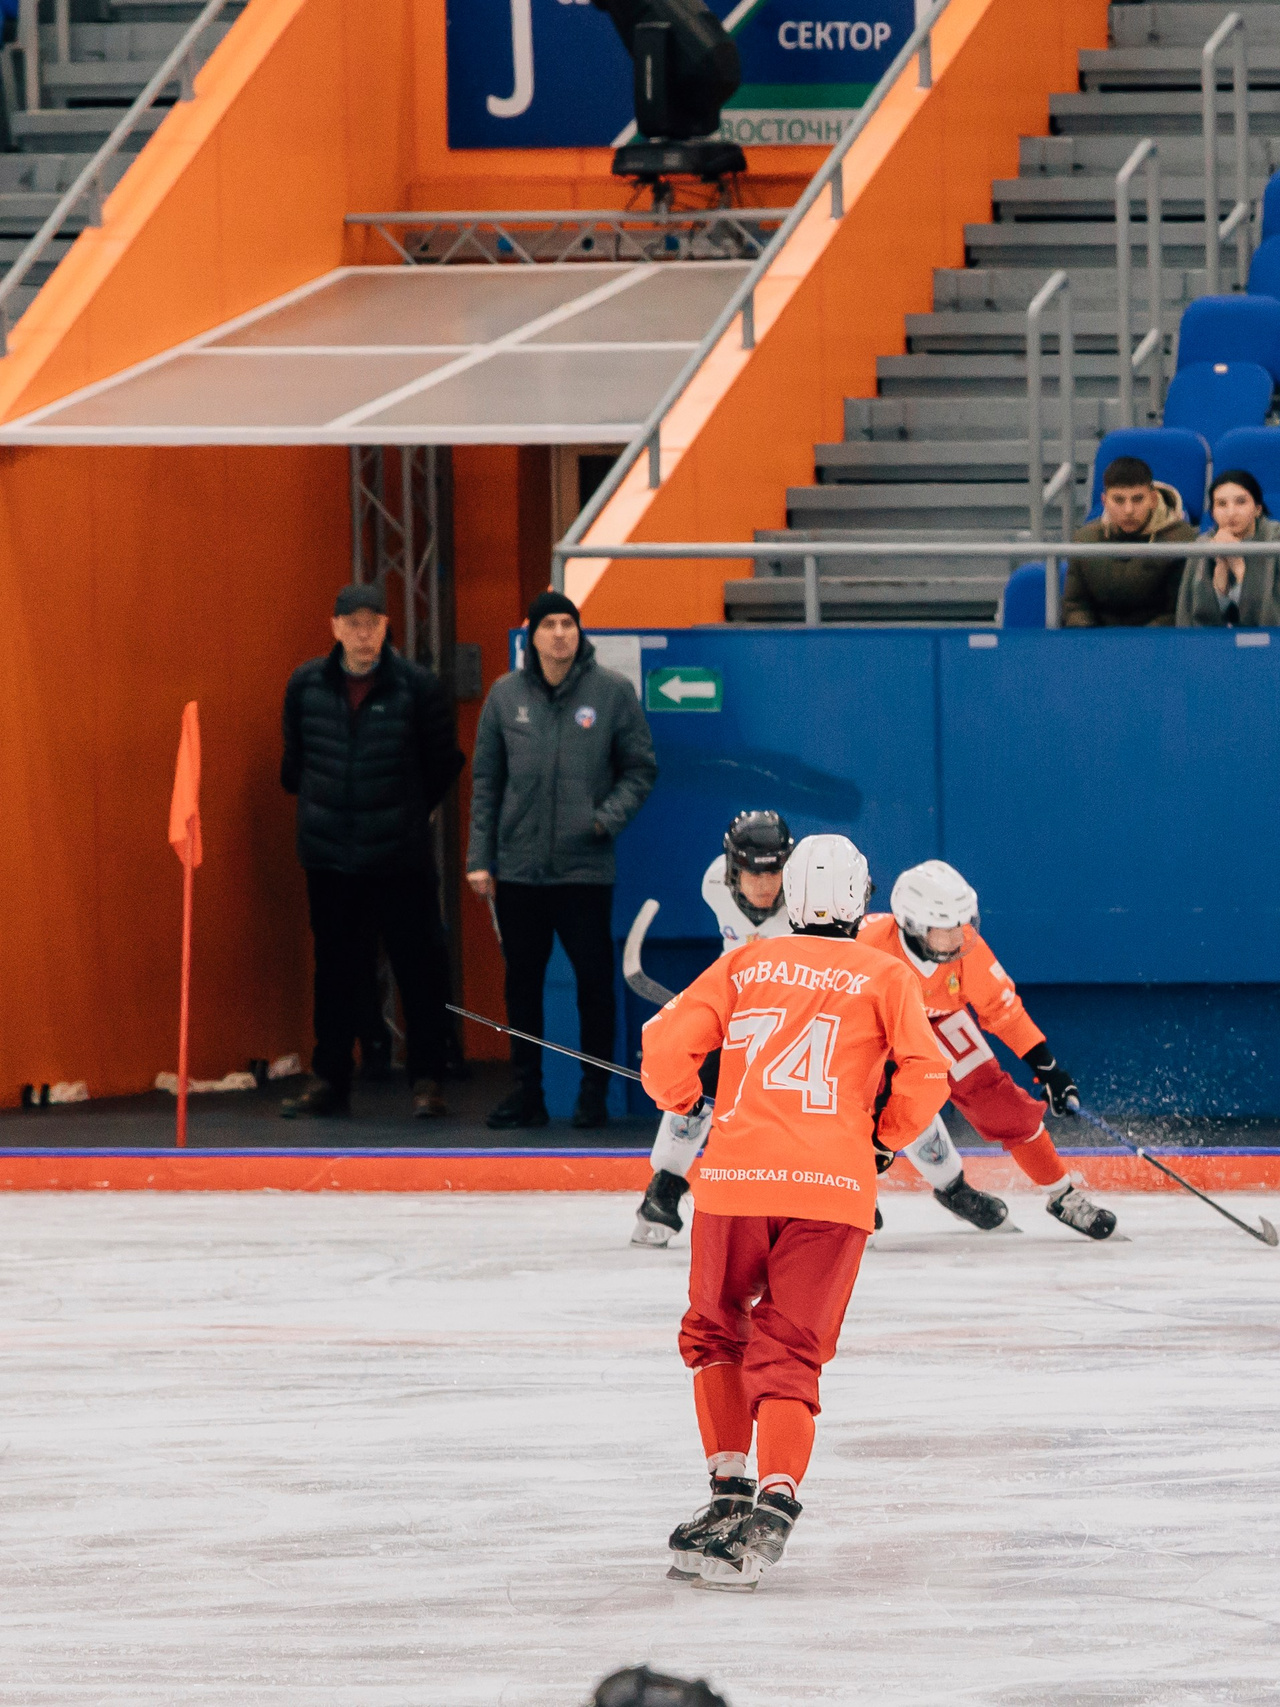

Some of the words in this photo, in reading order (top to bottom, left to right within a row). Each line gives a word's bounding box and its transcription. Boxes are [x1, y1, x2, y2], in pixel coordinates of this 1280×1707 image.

[778, 20, 892, 51] СЕКТОР
[716, 1006, 842, 1123] 74
[791, 1170, 861, 1192] ОБЛАСТЬ
